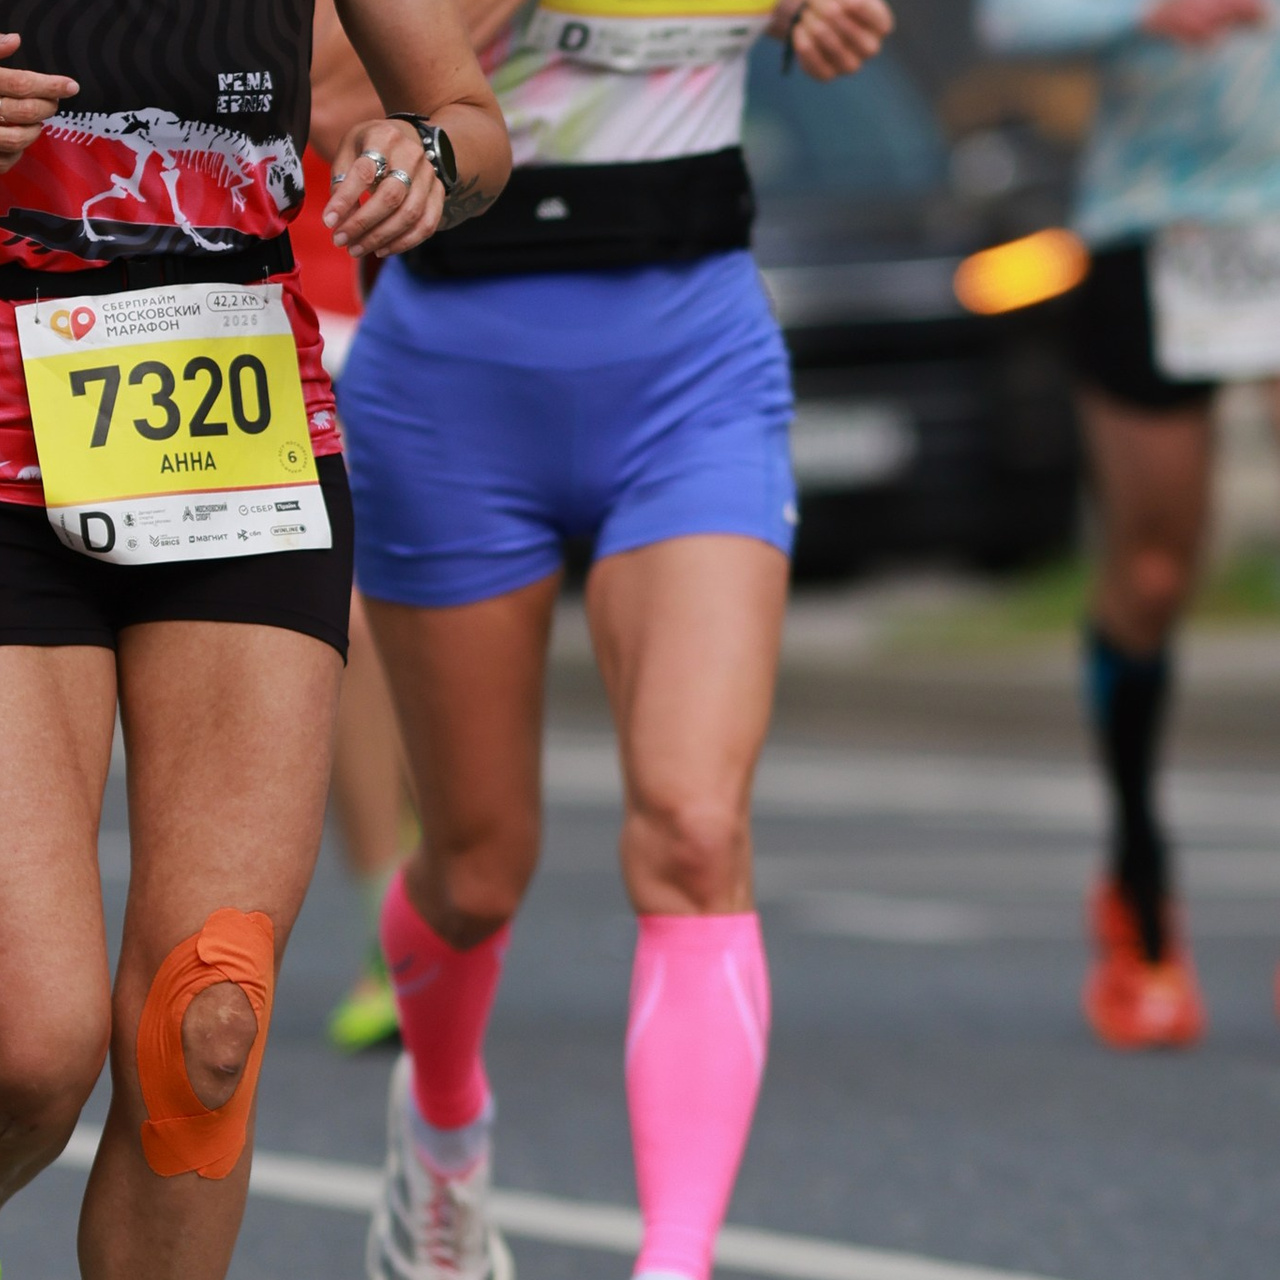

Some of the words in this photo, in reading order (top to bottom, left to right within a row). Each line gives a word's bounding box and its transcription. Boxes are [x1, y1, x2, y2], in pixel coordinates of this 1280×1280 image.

[102, 295, 176, 313] СБЕРПРАЙМ
[213, 295, 238, 308] 42,2
[104, 303, 201, 324] МОСКОВСКИЙ
[223, 314, 258, 327] 2026
[106, 319, 180, 337] МАРАФОН
[69, 354, 271, 448] 7320
[160, 451, 217, 474] АННА
[288, 451, 297, 463] 6
[250, 504, 273, 514] СБЕР
[79, 511, 116, 553] D
